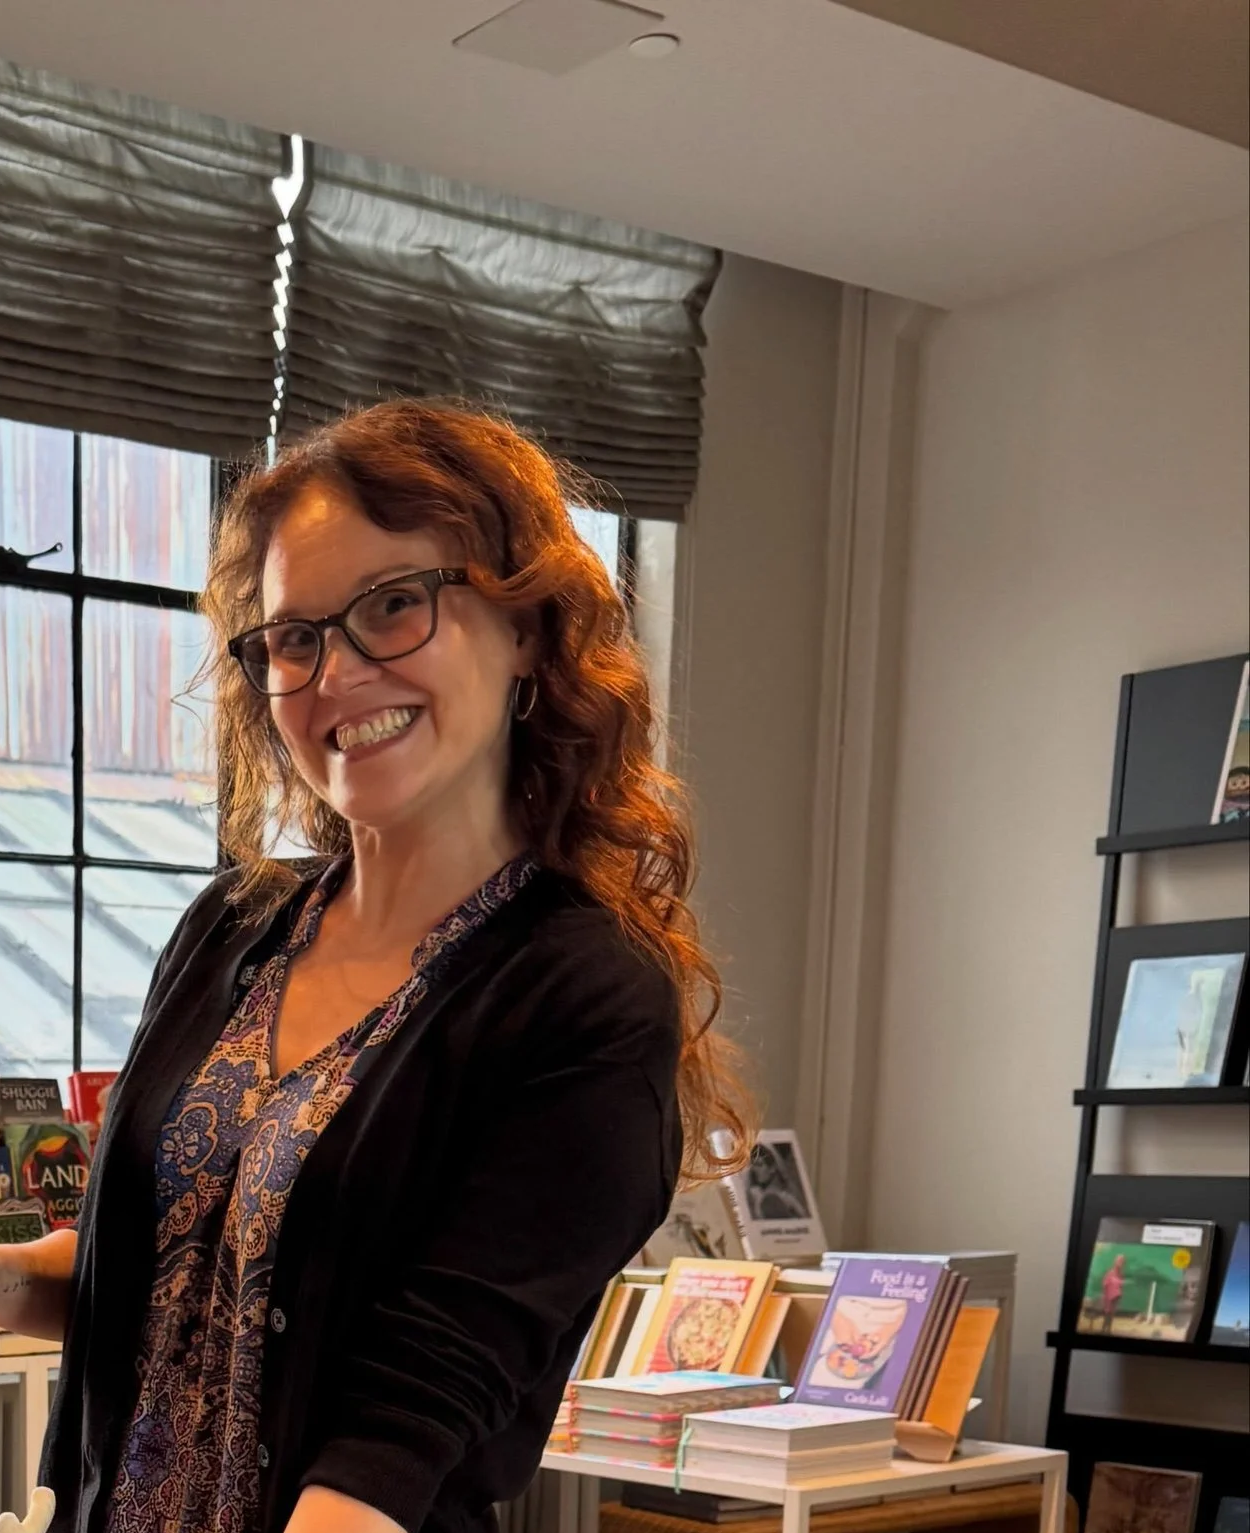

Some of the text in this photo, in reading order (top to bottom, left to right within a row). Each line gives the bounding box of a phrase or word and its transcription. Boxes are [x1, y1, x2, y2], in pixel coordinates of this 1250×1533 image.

[2, 1084, 58, 1100] SHUGGIE
[15, 1099, 48, 1112] BAIN
[27, 1164, 88, 1189] LAND
[870, 1269, 926, 1286] Food is a
[880, 1284, 928, 1303] Feeling
